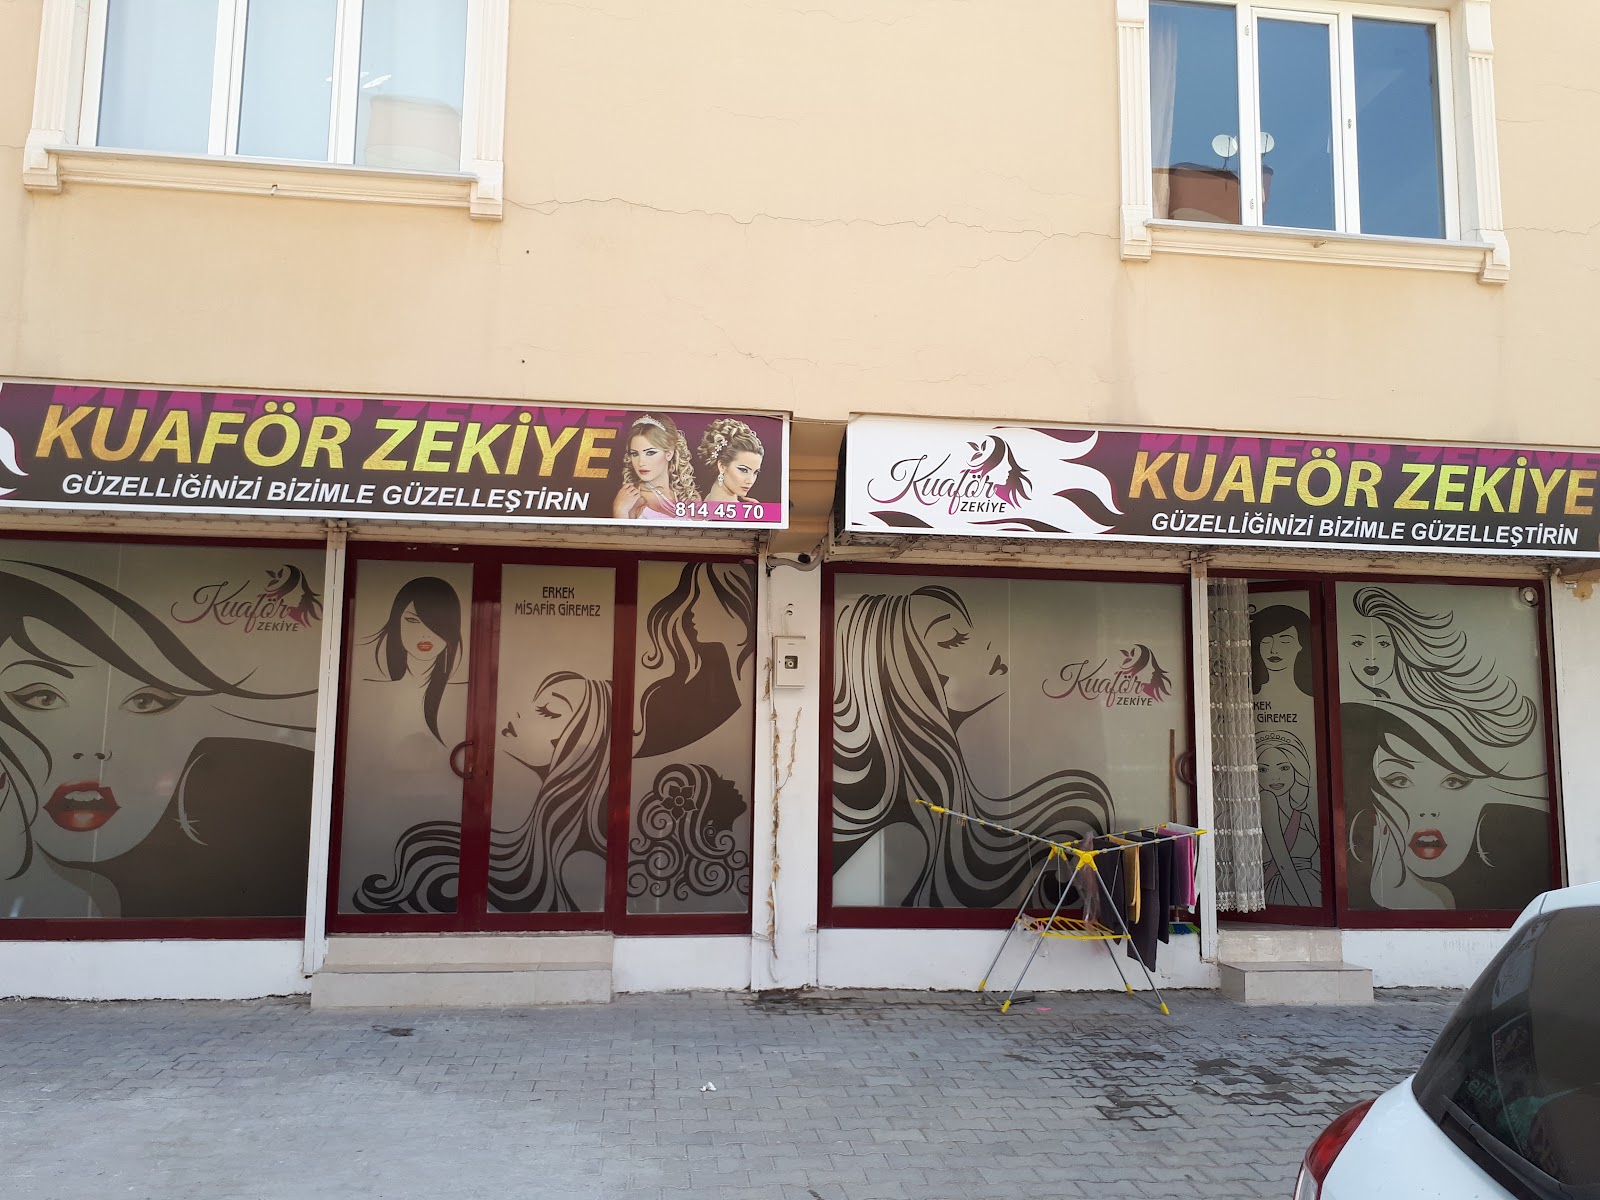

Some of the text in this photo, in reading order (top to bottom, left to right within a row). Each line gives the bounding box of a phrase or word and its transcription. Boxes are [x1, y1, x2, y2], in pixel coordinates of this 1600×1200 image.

[35, 401, 352, 469] KUAFÖR
[362, 412, 618, 479] ZEKİYE
[867, 453, 996, 515] Kuaför
[1128, 447, 1383, 508] KUAFÖR
[1393, 456, 1598, 516] ZEKİYE
[62, 471, 589, 513] GÜZELLİĞİNİZİ BİZİMLE GÜZELLEŞTİRİN
[675, 501, 764, 520] 814 45 70
[960, 499, 1007, 514] ZEKİYE
[1151, 510, 1579, 547] GÜZELLİĞİNİZİ BİZİMLE GÜZELLEŞTİRİN
[542, 586, 575, 599] ERKEK
[170, 580, 289, 634] Kuaför
[515, 600, 601, 617] MİSAFİR GİREMEZ
[257, 621, 299, 632] ZEKİYE
[1042, 659, 1143, 707] Kuaför
[1116, 696, 1153, 706] ZEKİYE
[1253, 701, 1272, 711] KEK
[1257, 711, 1298, 723] GİREMEZ
